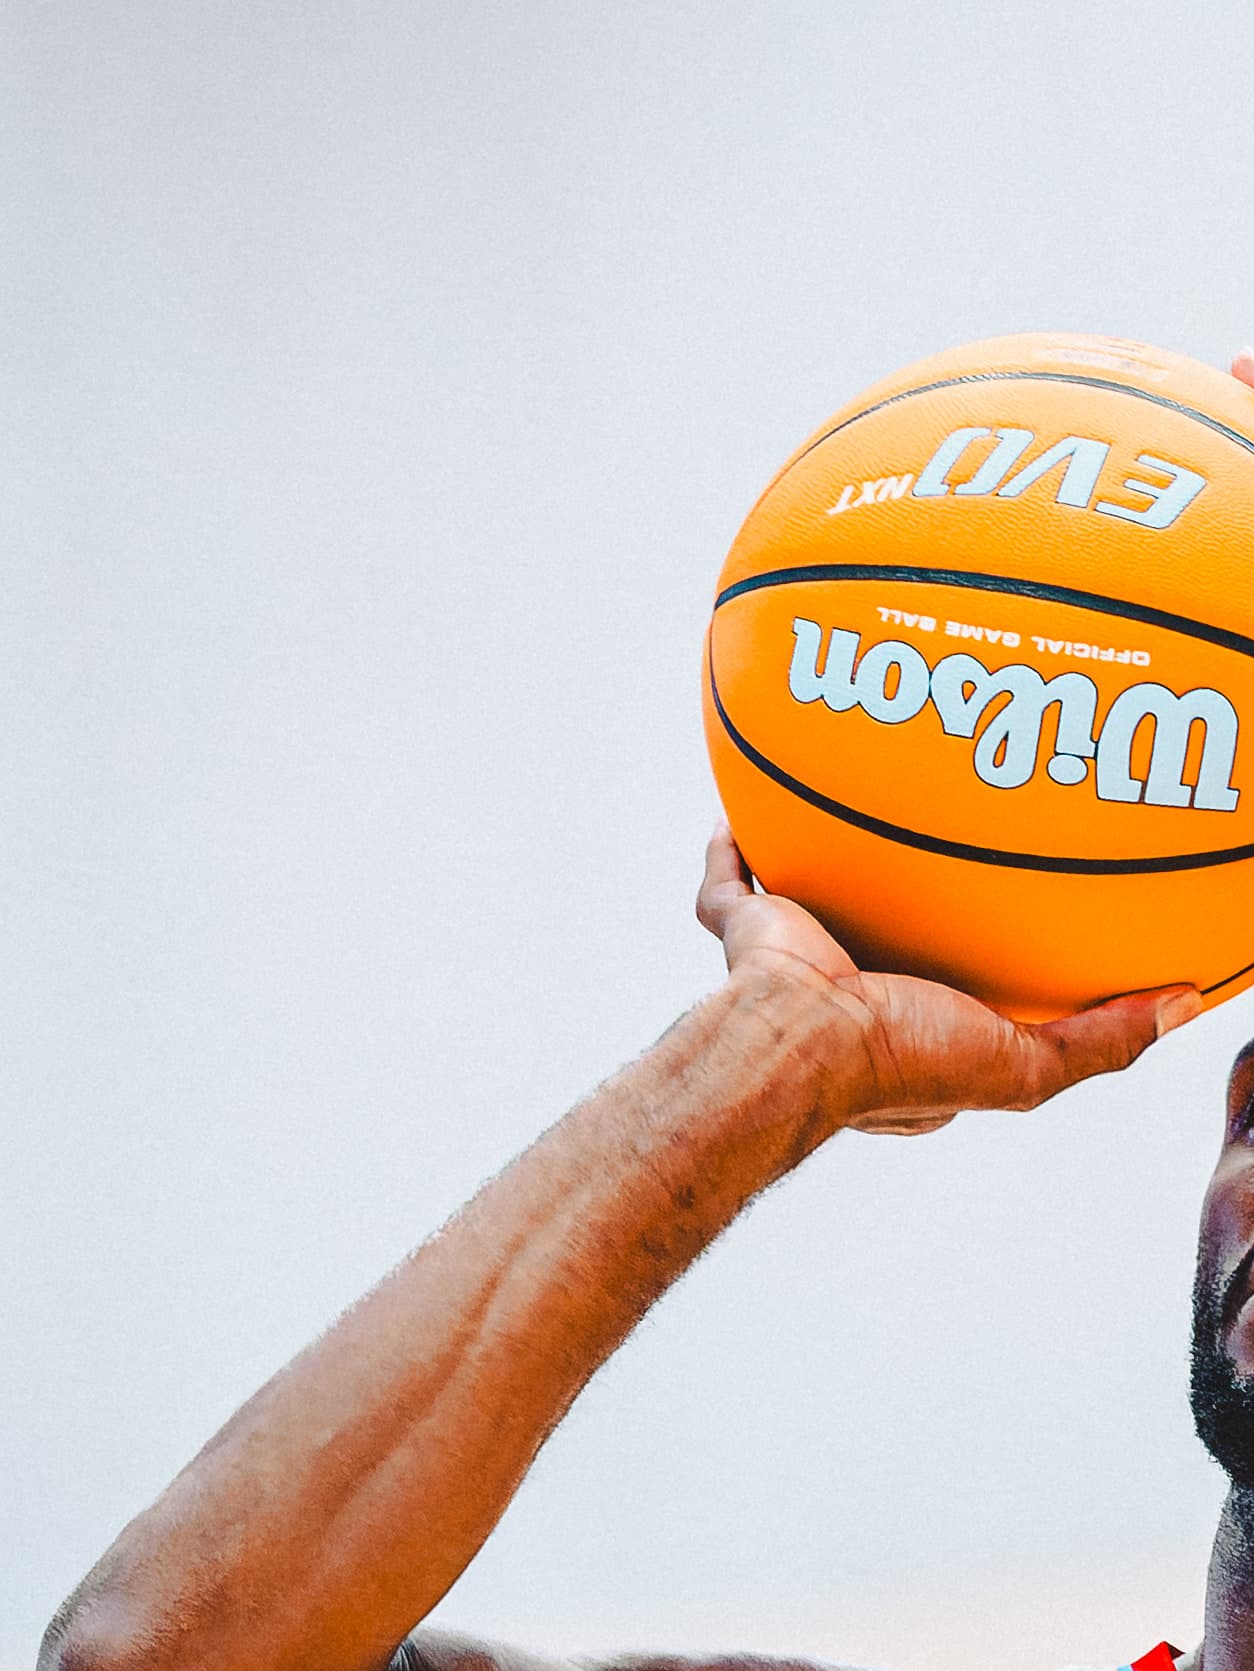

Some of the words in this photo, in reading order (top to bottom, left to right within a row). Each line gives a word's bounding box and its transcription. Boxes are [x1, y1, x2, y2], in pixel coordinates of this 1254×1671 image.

[826, 473, 914, 515] NXT
[912, 427, 1207, 529] EVO
[876, 606, 936, 632] BALL
[944, 620, 1021, 648] GAME
[1031, 636, 1150, 667] OFFICIAL
[788, 616, 1240, 812] Wilson
